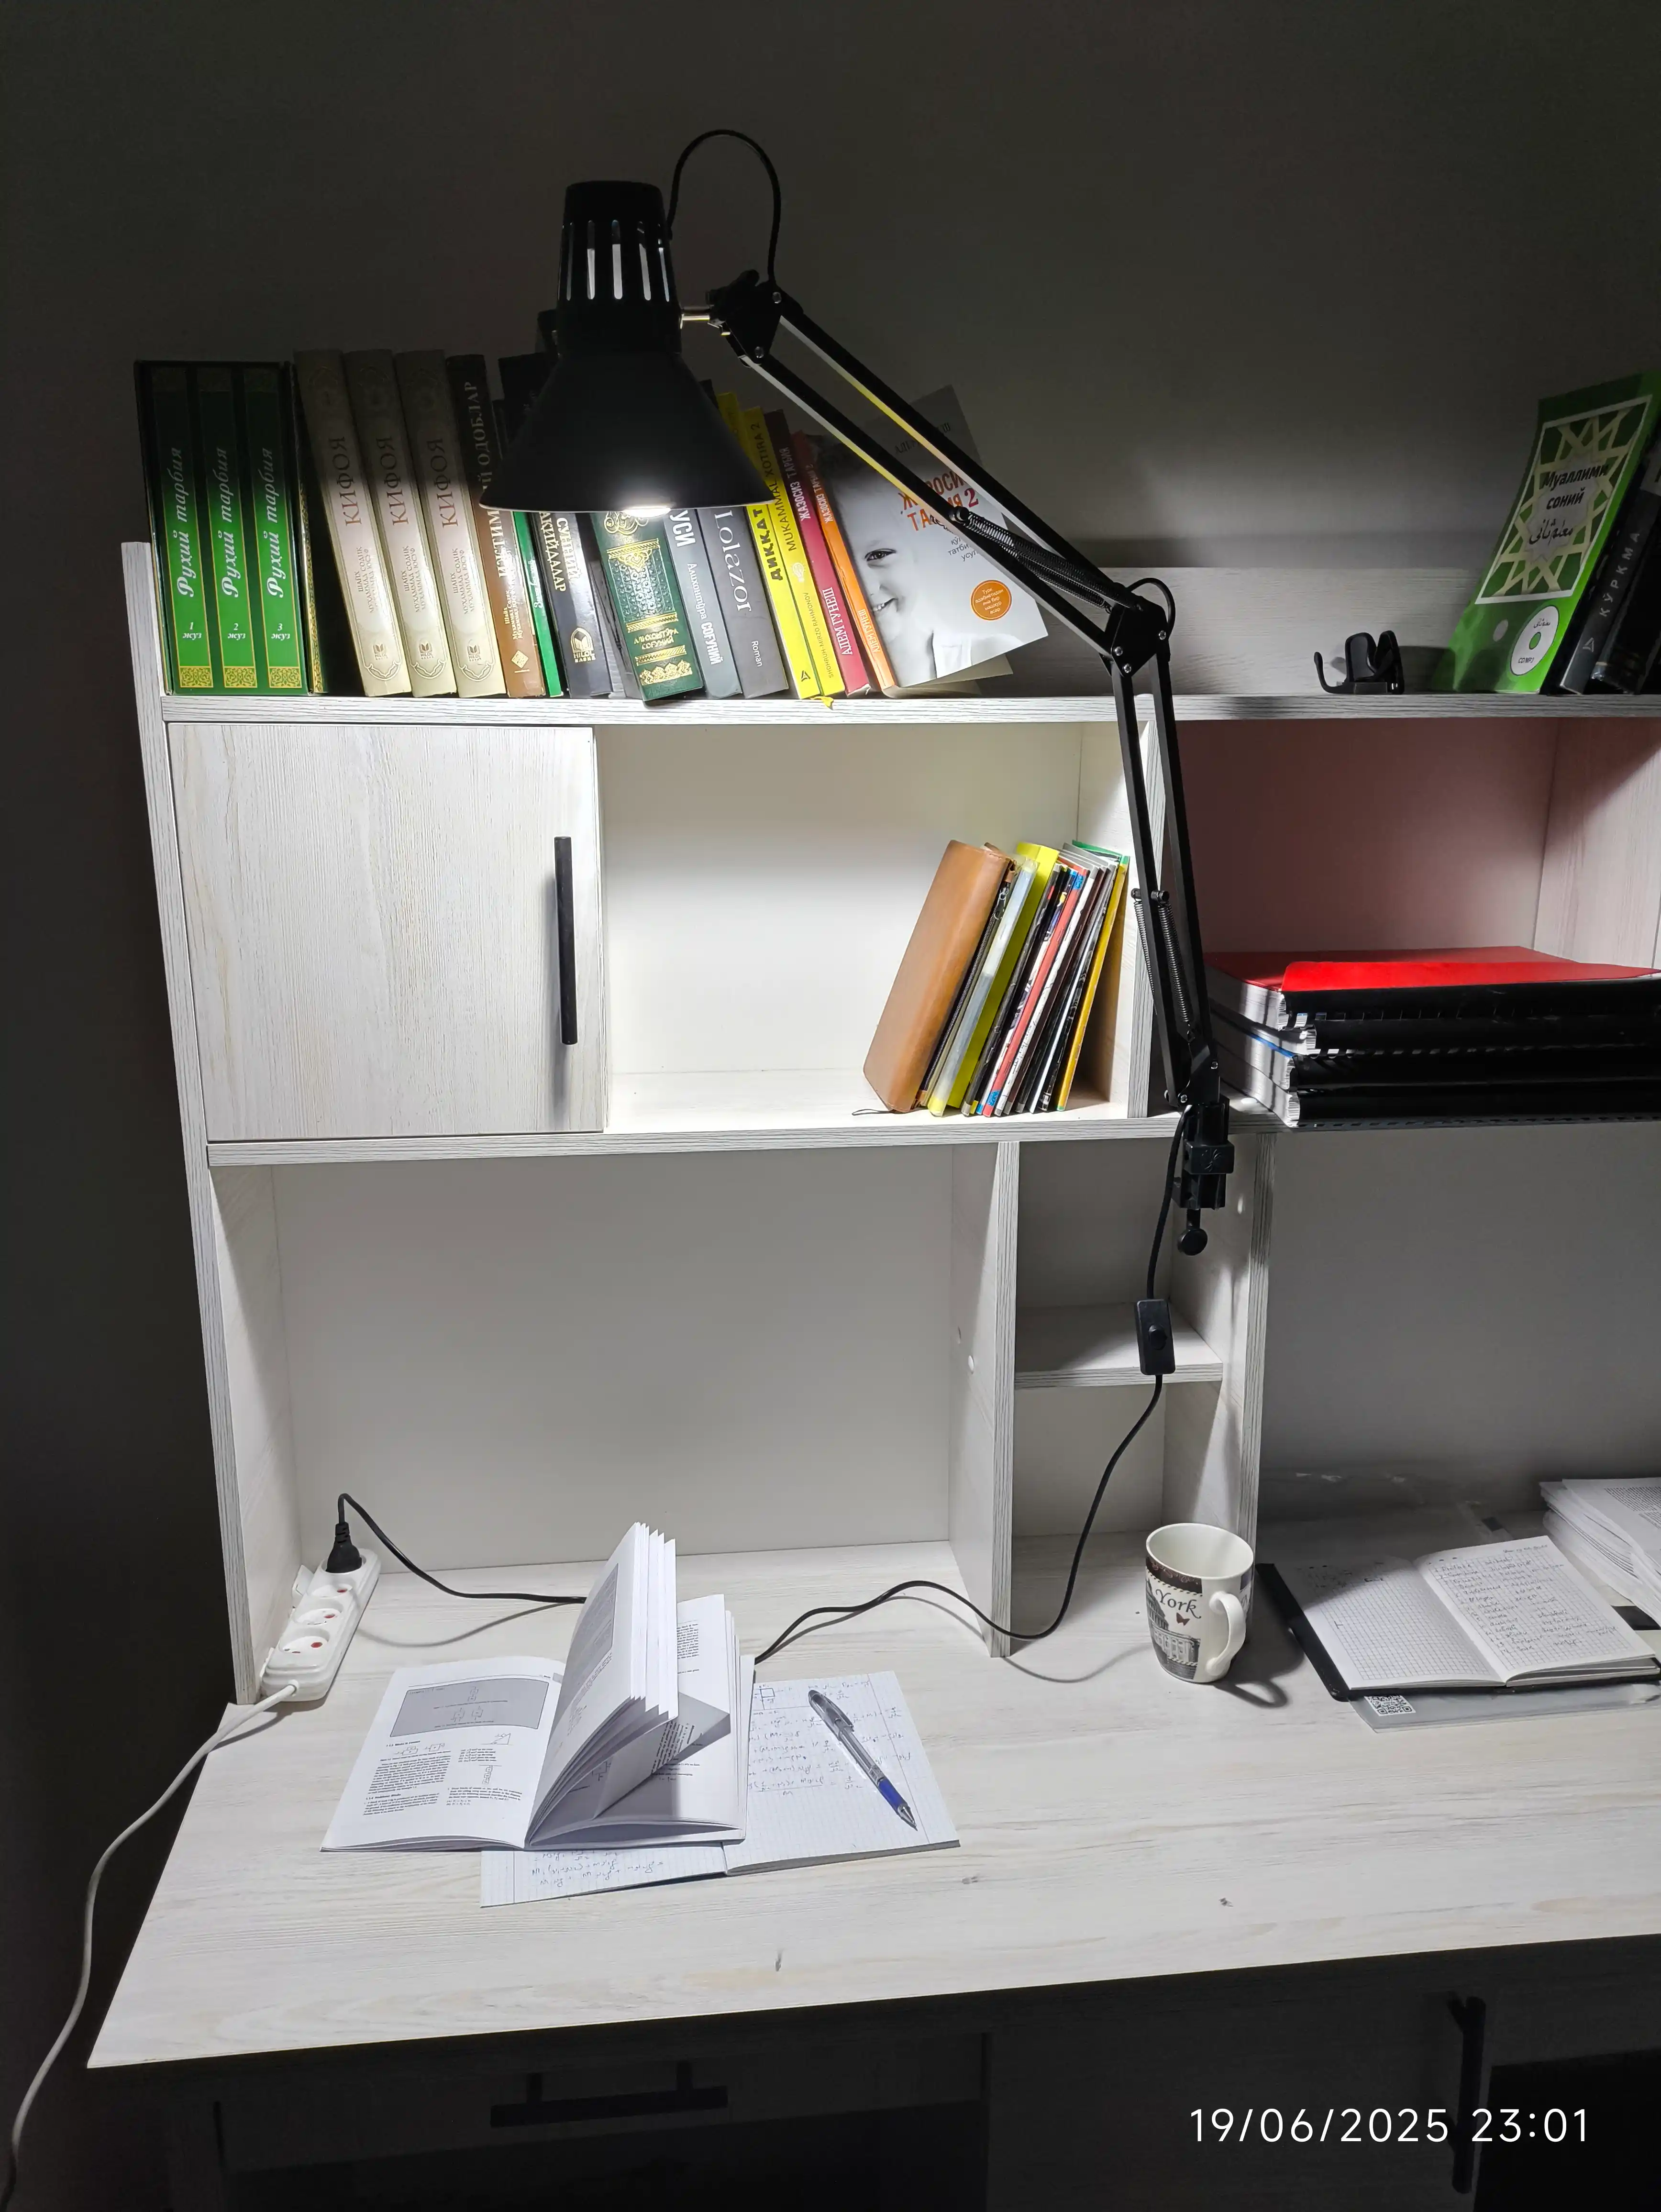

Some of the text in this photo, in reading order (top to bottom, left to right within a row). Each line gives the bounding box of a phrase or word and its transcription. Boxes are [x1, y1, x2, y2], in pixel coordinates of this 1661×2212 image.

[464, 381, 491, 466] ОДОБЛАР
[166, 448, 189, 522] тарбия
[212, 448, 234, 522] тарбия
[257, 448, 279, 523] тарбия
[328, 436, 362, 527] КИФОЯ
[376, 437, 409, 526] КИФОЯ
[427, 438, 458, 528] КИФОЯ
[750, 422, 797, 552] MUKAMMAL XOTIRA 2
[779, 447, 811, 521] ЖАЗОСИЗ ТАРБИЯ
[964, 487, 979, 508] 2
[1541, 465, 1609, 491] Муаллими
[816, 493, 834, 523] ЖАЗОСИЗ
[1546, 487, 1586, 510] соний
[556, 518, 582, 579] СУННИЙ
[670, 510, 696, 547] УСИ
[753, 509, 783, 581] ДИҚҚАТ
[410, 548, 418, 568] ЮСУФ
[459, 550, 469, 571] ЮСУФ
[714, 510, 752, 611] Lolazor
[947, 543, 970, 556] татби
[355, 571, 364, 592] ШАЙХ
[401, 571, 410, 591] ШАЙХ
[450, 573, 458, 593] ШАЙХ
[189, 622, 194, 630] 1
[233, 623, 239, 631] 2
[803, 592, 834, 678] SHOHRUH-MIRZO RAHMONOV
[822, 586, 853, 655] АДЕМ ГУНЕШ
[858, 609, 881, 653] АДЕМ ГУНЕШ
[752, 640, 763, 667] Roman
[1155, 1589, 1202, 1619] York
